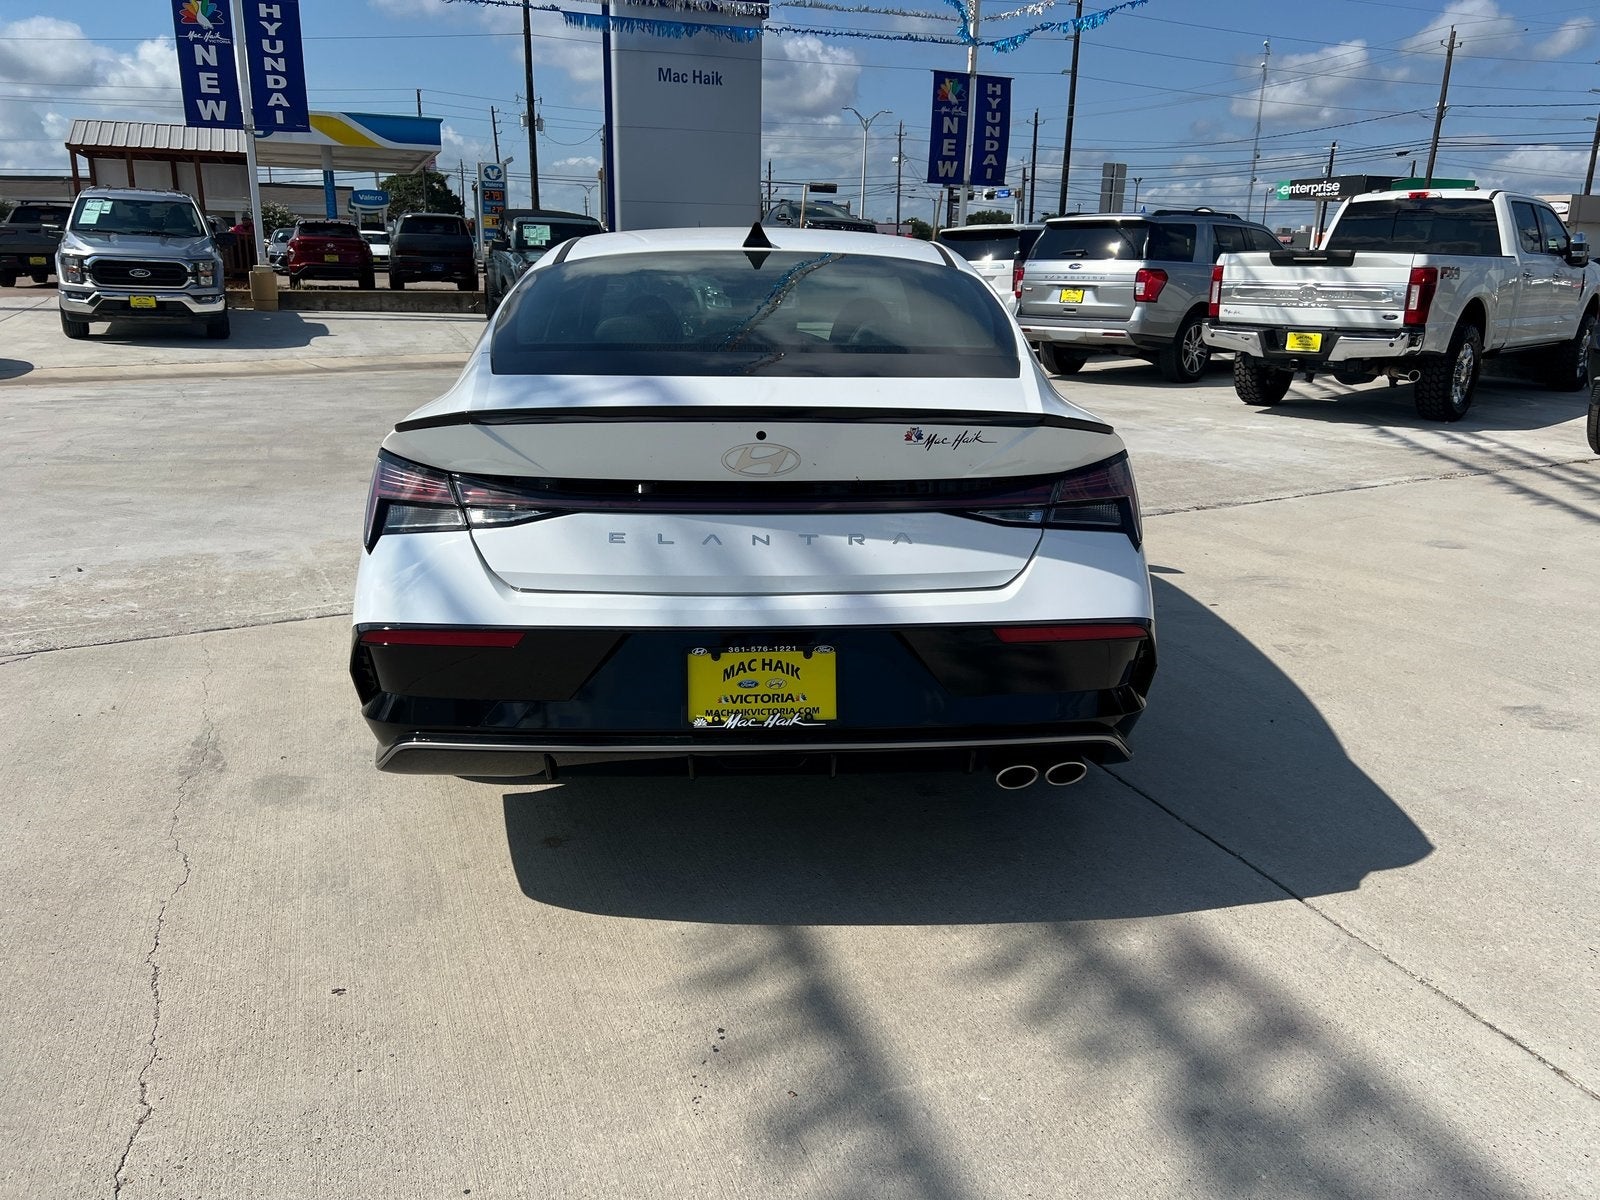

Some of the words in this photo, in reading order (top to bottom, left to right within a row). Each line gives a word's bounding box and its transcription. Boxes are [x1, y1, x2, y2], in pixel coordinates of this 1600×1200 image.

[258, 3, 290, 124] HYUNDAI
[194, 44, 227, 121] NEW
[657, 67, 688, 83] Mac
[692, 70, 723, 86] Haik
[982, 83, 1002, 179] HYUNDAI
[937, 116, 959, 178] NEW
[1278, 181, 1340, 196] enterprise
[924, 434, 949, 451] Mac
[951, 430, 990, 450] Haik
[608, 532, 913, 546] ELANTRA
[723, 659, 758, 682] MAC
[761, 658, 801, 680] HAIK
[730, 694, 795, 704] VICTORIA
[705, 707, 820, 717] MACHAIKVICTORIA.COM
[724, 713, 762, 729] Mac
[763, 712, 812, 728] Haik
